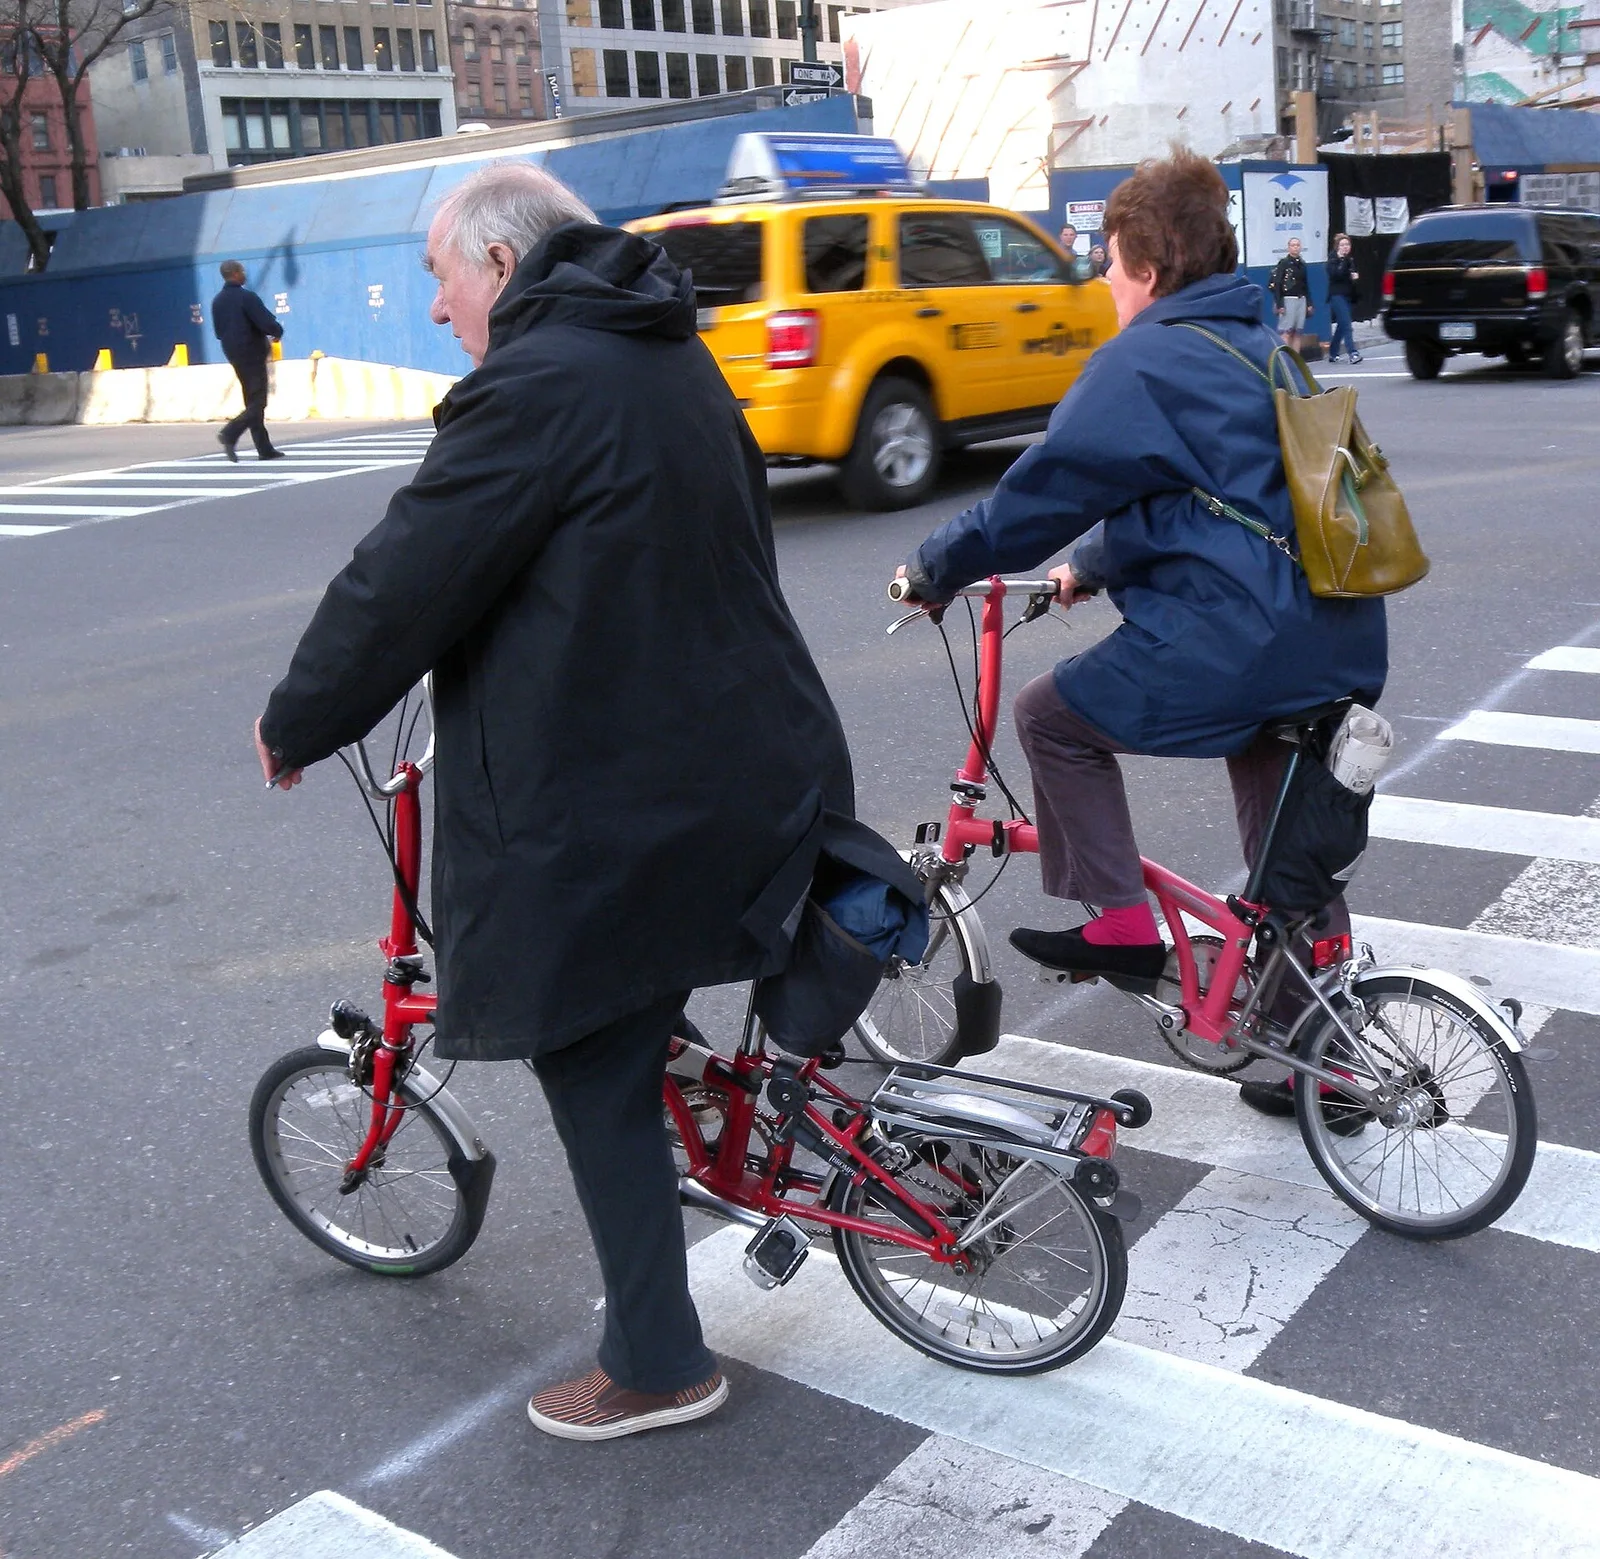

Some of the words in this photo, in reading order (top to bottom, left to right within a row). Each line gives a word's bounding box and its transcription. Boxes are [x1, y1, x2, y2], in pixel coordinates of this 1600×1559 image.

[797, 69, 813, 79] ONE
[820, 71, 836, 81] WAY
[1273, 197, 1303, 218] Bovis
